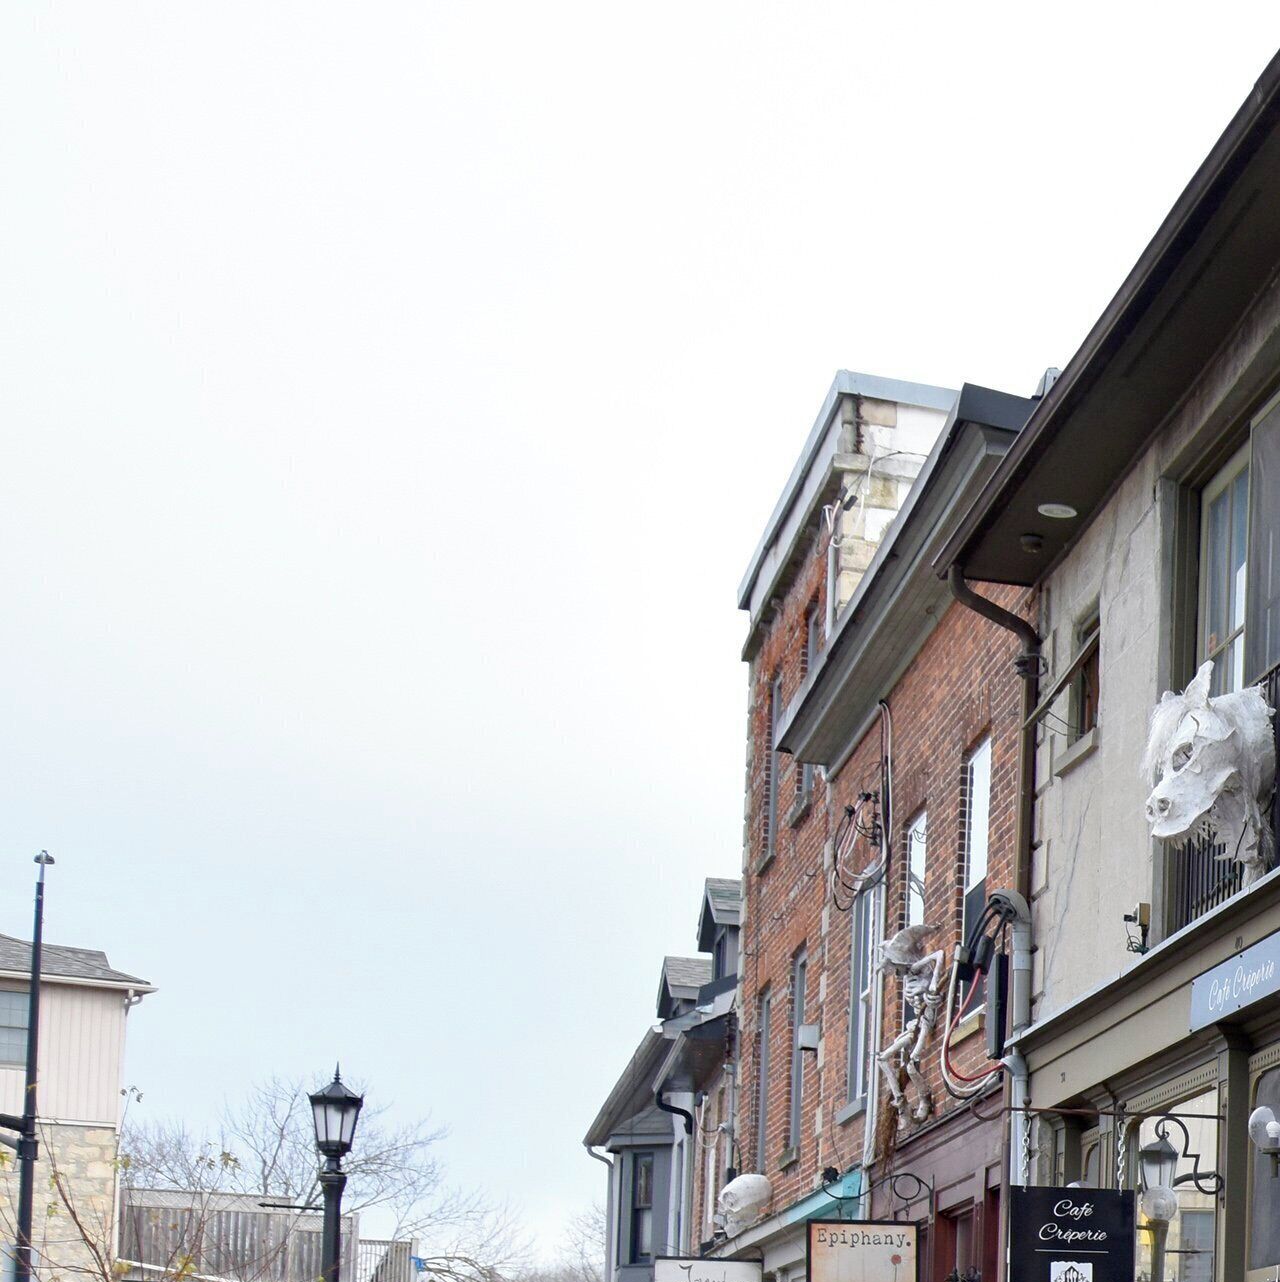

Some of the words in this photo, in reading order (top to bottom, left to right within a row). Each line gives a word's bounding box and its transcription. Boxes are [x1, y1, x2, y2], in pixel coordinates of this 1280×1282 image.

[1208, 978, 1232, 1012] Café
[1053, 1199, 1095, 1220] Café
[816, 1227, 912, 1248] Epiphany.
[1038, 1222, 1108, 1244] Crêperie
